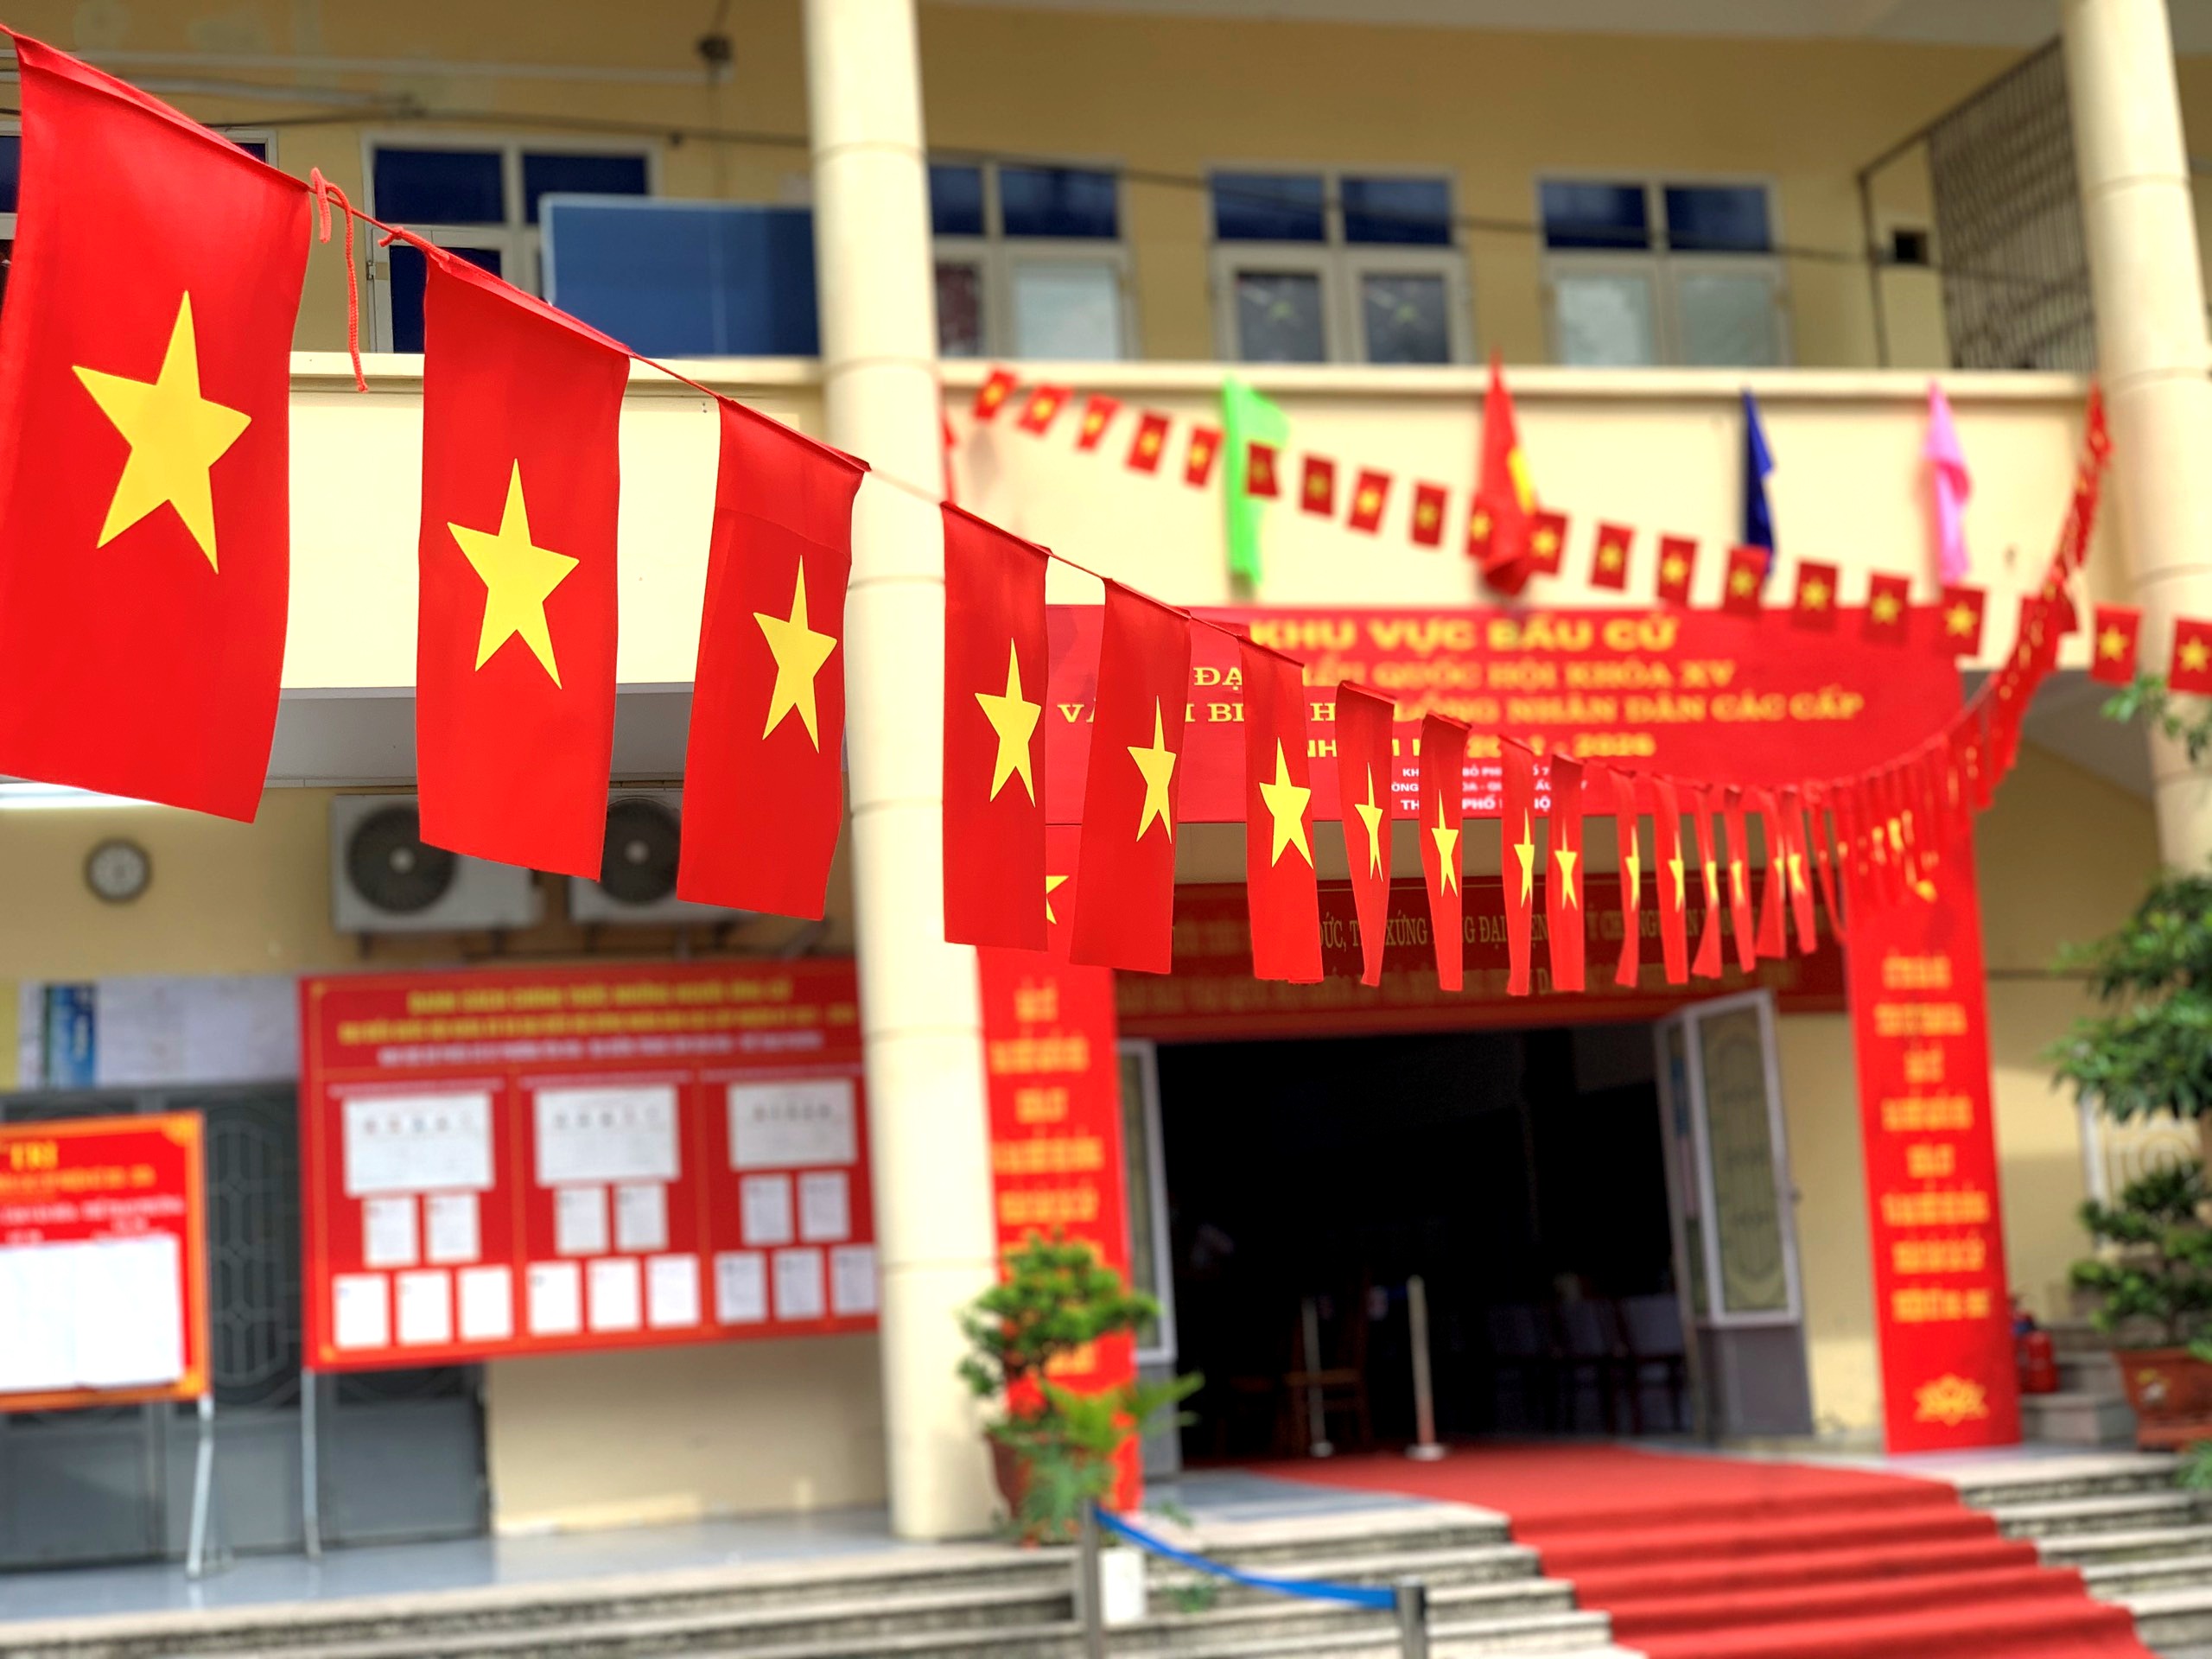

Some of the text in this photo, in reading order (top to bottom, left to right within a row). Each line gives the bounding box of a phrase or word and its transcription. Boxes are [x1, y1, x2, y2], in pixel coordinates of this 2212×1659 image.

[1249, 619, 1355, 650] KHU
[1368, 618, 1474, 658] VỰC
[1193, 666, 1243, 690] ĐẠ
[1057, 698, 1096, 722] V
[1207, 703, 1244, 721] BI
[1402, 768, 1419, 777] KH
[1386, 909, 1427, 946] XỨNG
[1479, 915, 1507, 950] ĐẠI
